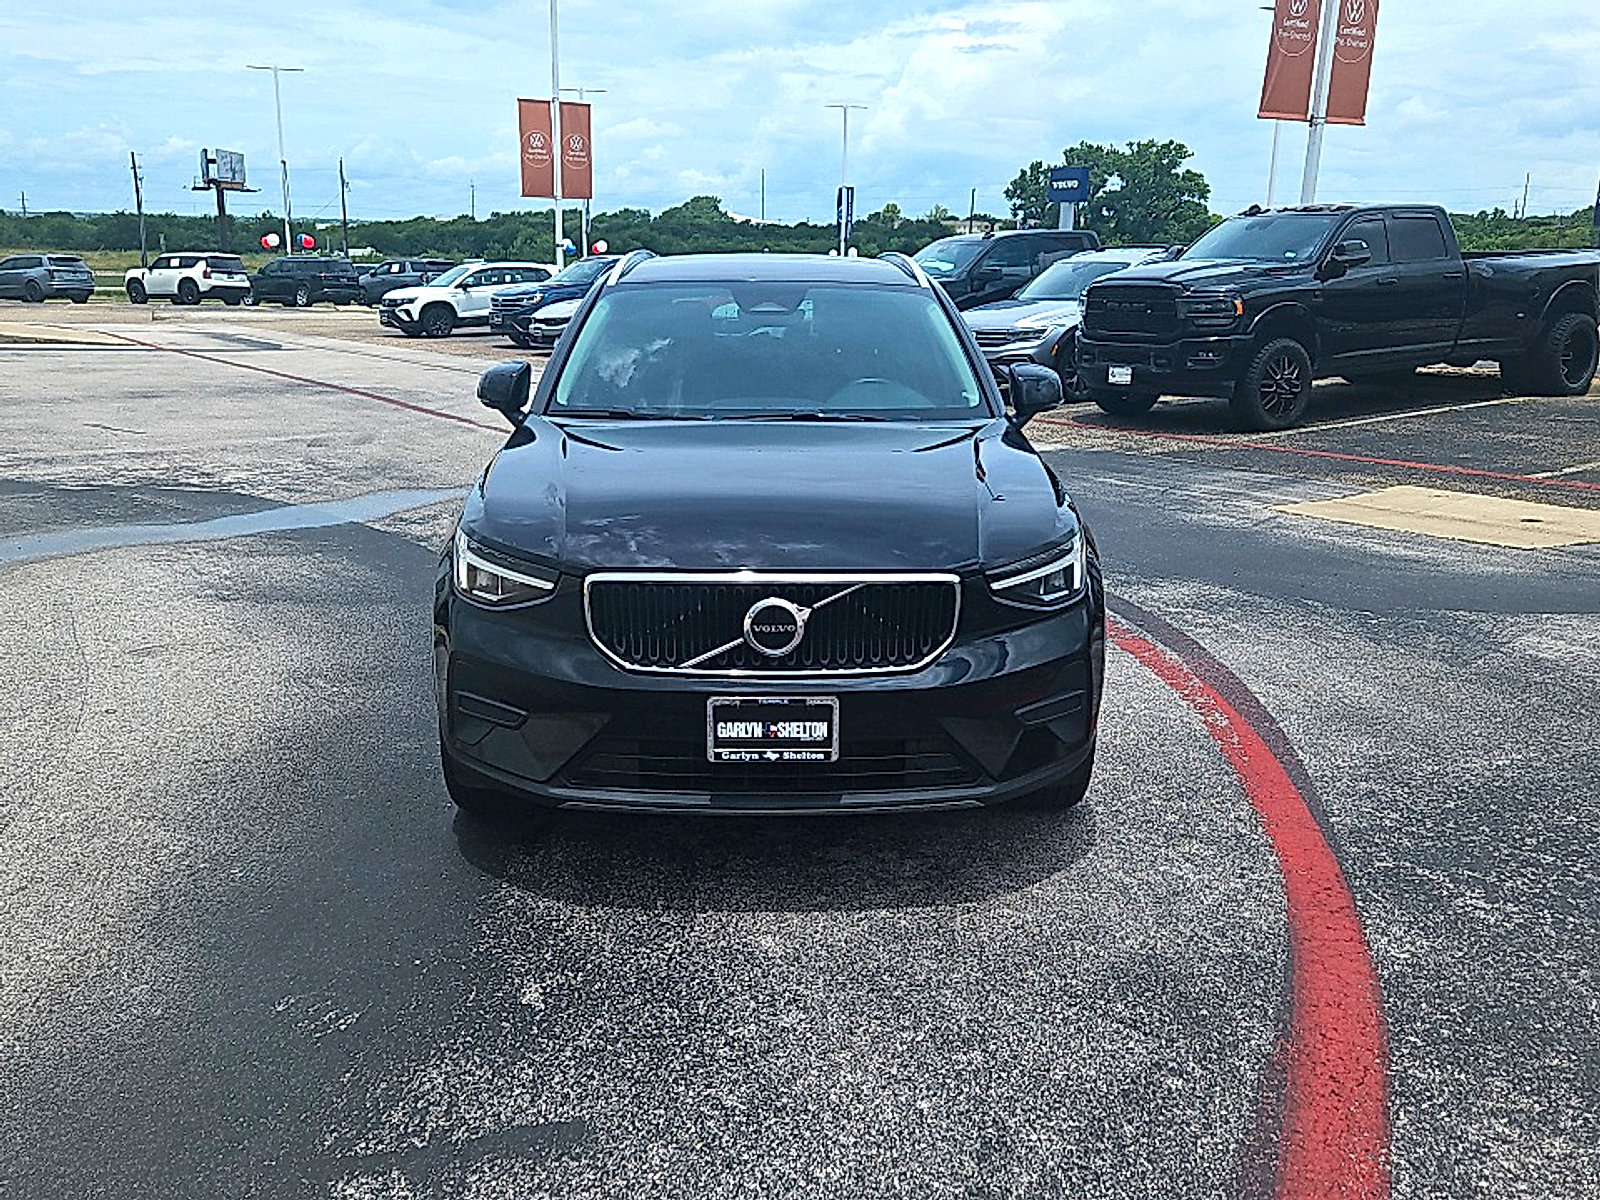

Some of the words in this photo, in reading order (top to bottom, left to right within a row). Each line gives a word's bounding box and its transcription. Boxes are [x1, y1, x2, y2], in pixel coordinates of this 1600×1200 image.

[1283, 16, 1310, 29] Certified
[1339, 25, 1367, 37] Certified
[1051, 179, 1079, 190] VOLVO
[752, 624, 796, 633] VOLVO
[717, 721, 763, 738] GARLYN
[777, 721, 828, 738] SHELTON
[721, 751, 759, 762] Garlyn
[782, 751, 825, 760] Shelton
